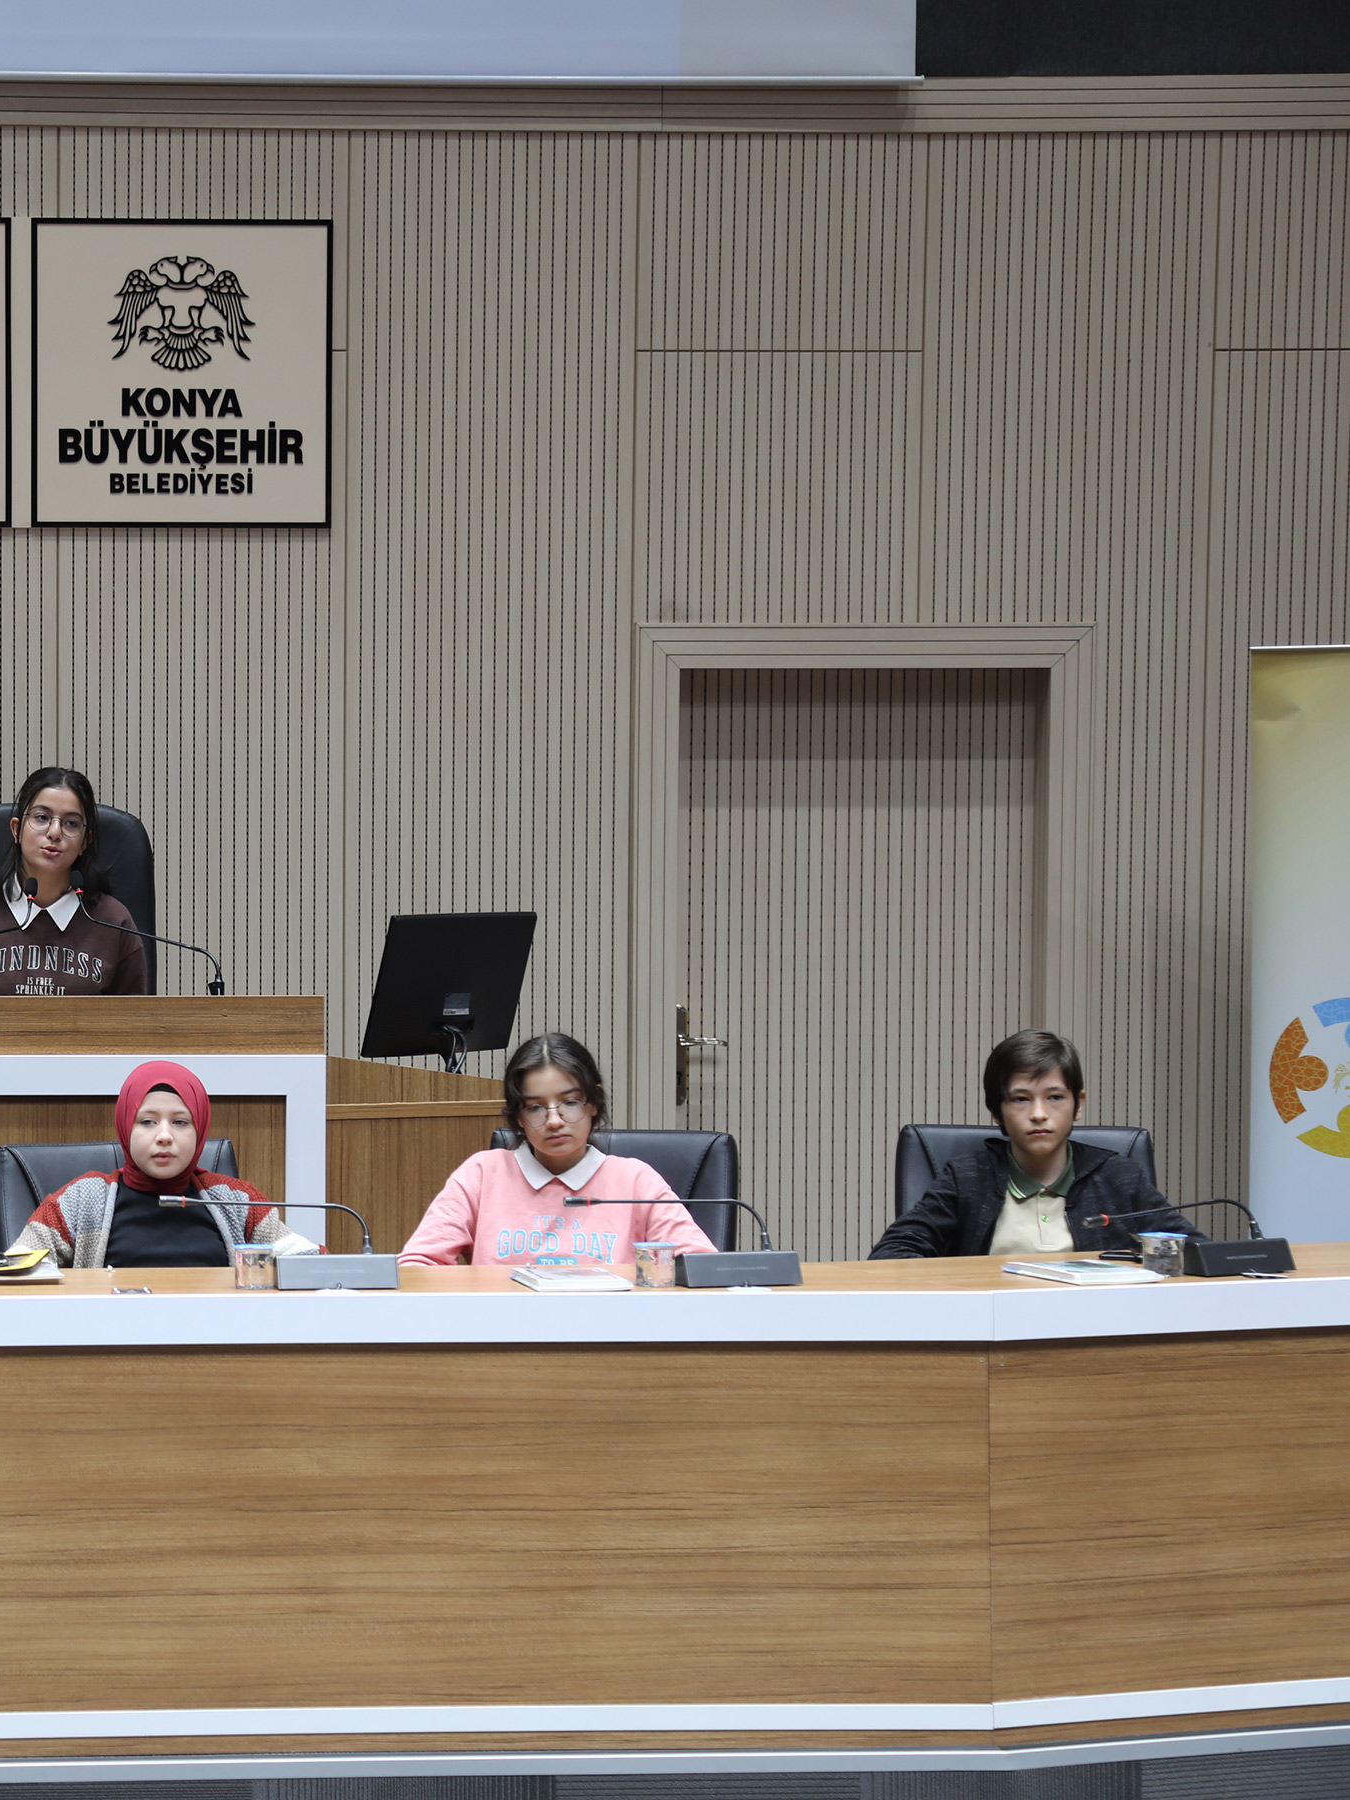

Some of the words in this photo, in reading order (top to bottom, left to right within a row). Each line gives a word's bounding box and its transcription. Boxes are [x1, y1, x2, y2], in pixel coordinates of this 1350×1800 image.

[121, 387, 243, 418] KONYA
[58, 420, 304, 470] BÜYÜKŞEHİR
[109, 468, 254, 495] BELEDİYESİ
[15, 984, 54, 996] SPRINKLE
[57, 986, 66, 996] IT
[27, 976, 34, 985] IS
[535, 1215, 565, 1230] IT'S
[572, 1219, 583, 1230] A
[497, 1228, 560, 1258] GOOD
[571, 1232, 618, 1264] DAY
